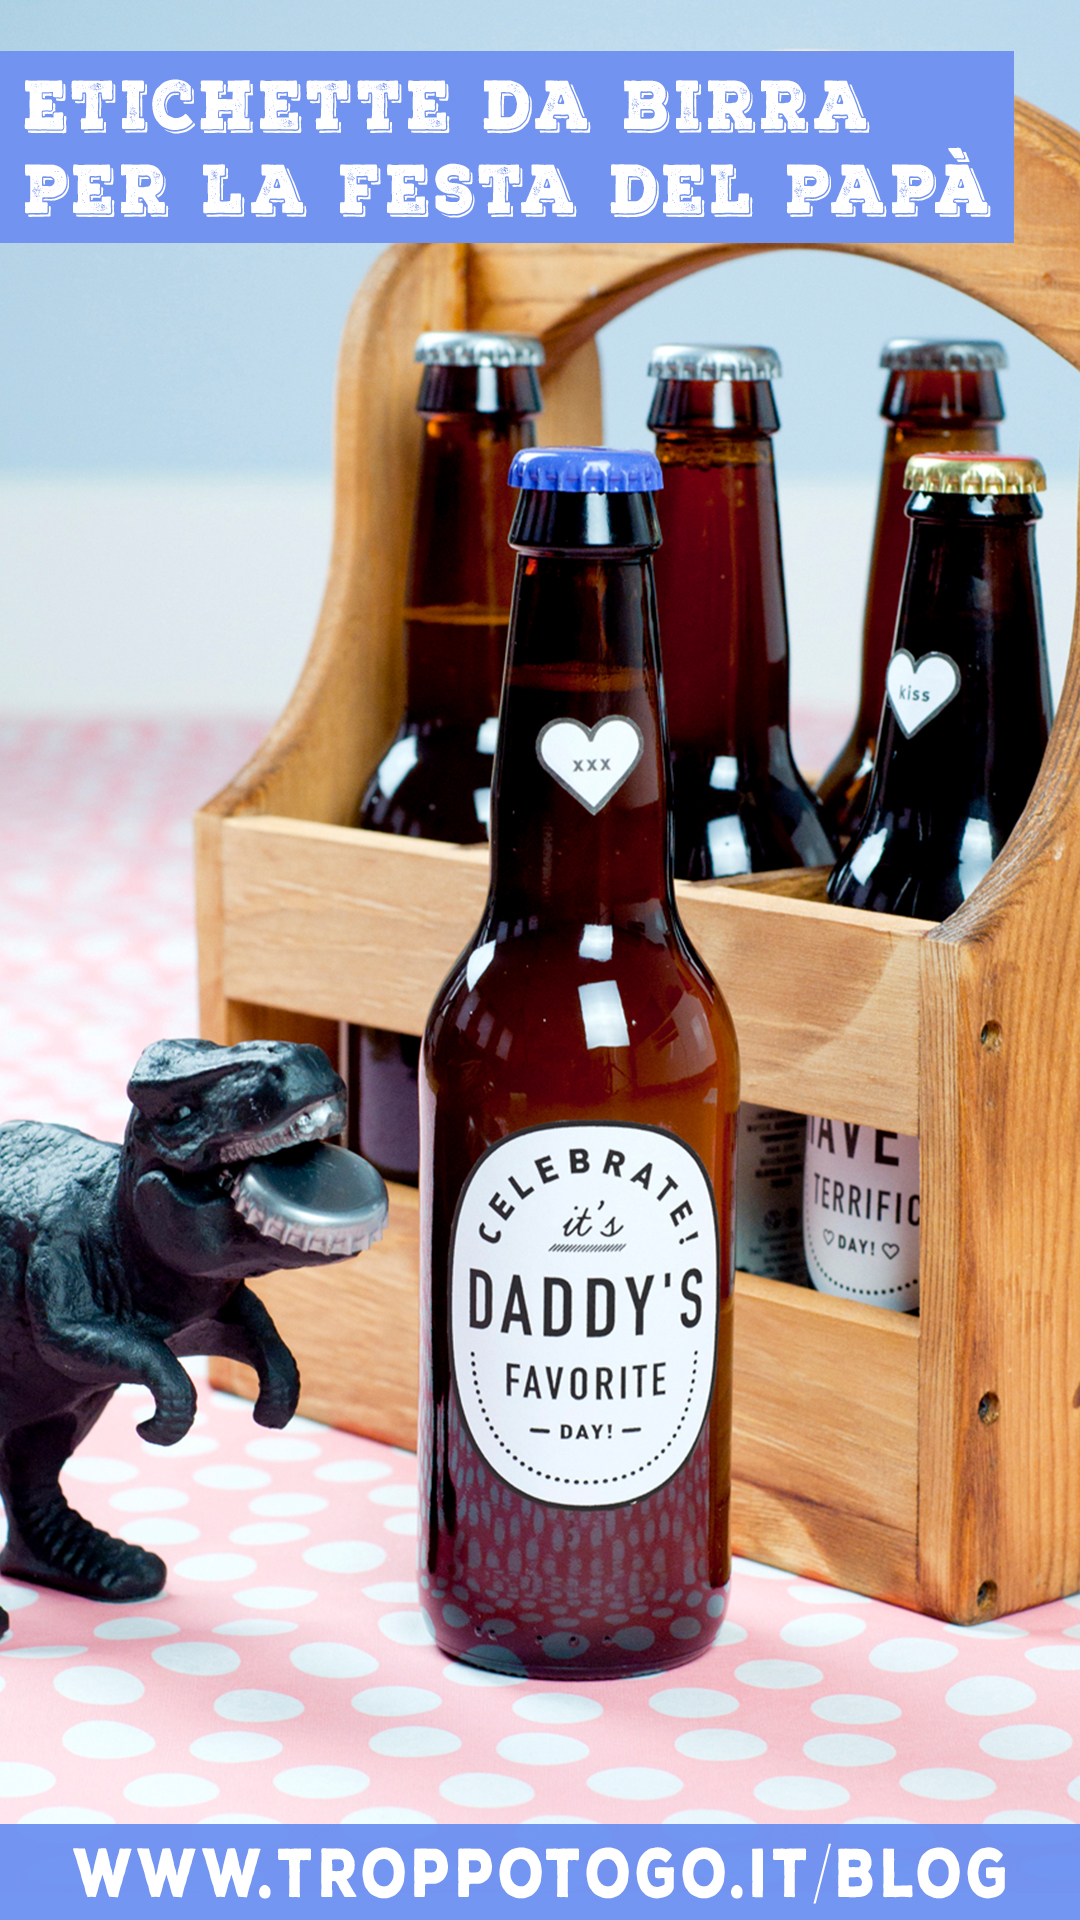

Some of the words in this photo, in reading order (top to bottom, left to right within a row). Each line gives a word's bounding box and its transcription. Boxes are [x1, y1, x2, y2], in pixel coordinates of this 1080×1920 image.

[899, 685, 931, 702] kiss
[479, 1148, 699, 1245] CELEBRATE!
[814, 1172, 919, 1227] TERRIFIC
[563, 1200, 625, 1238] it's
[838, 1234, 875, 1256] DAY!
[469, 1267, 704, 1338] DADDY'S
[506, 1361, 667, 1401] FAVORITE
[560, 1424, 614, 1440] DAY!
